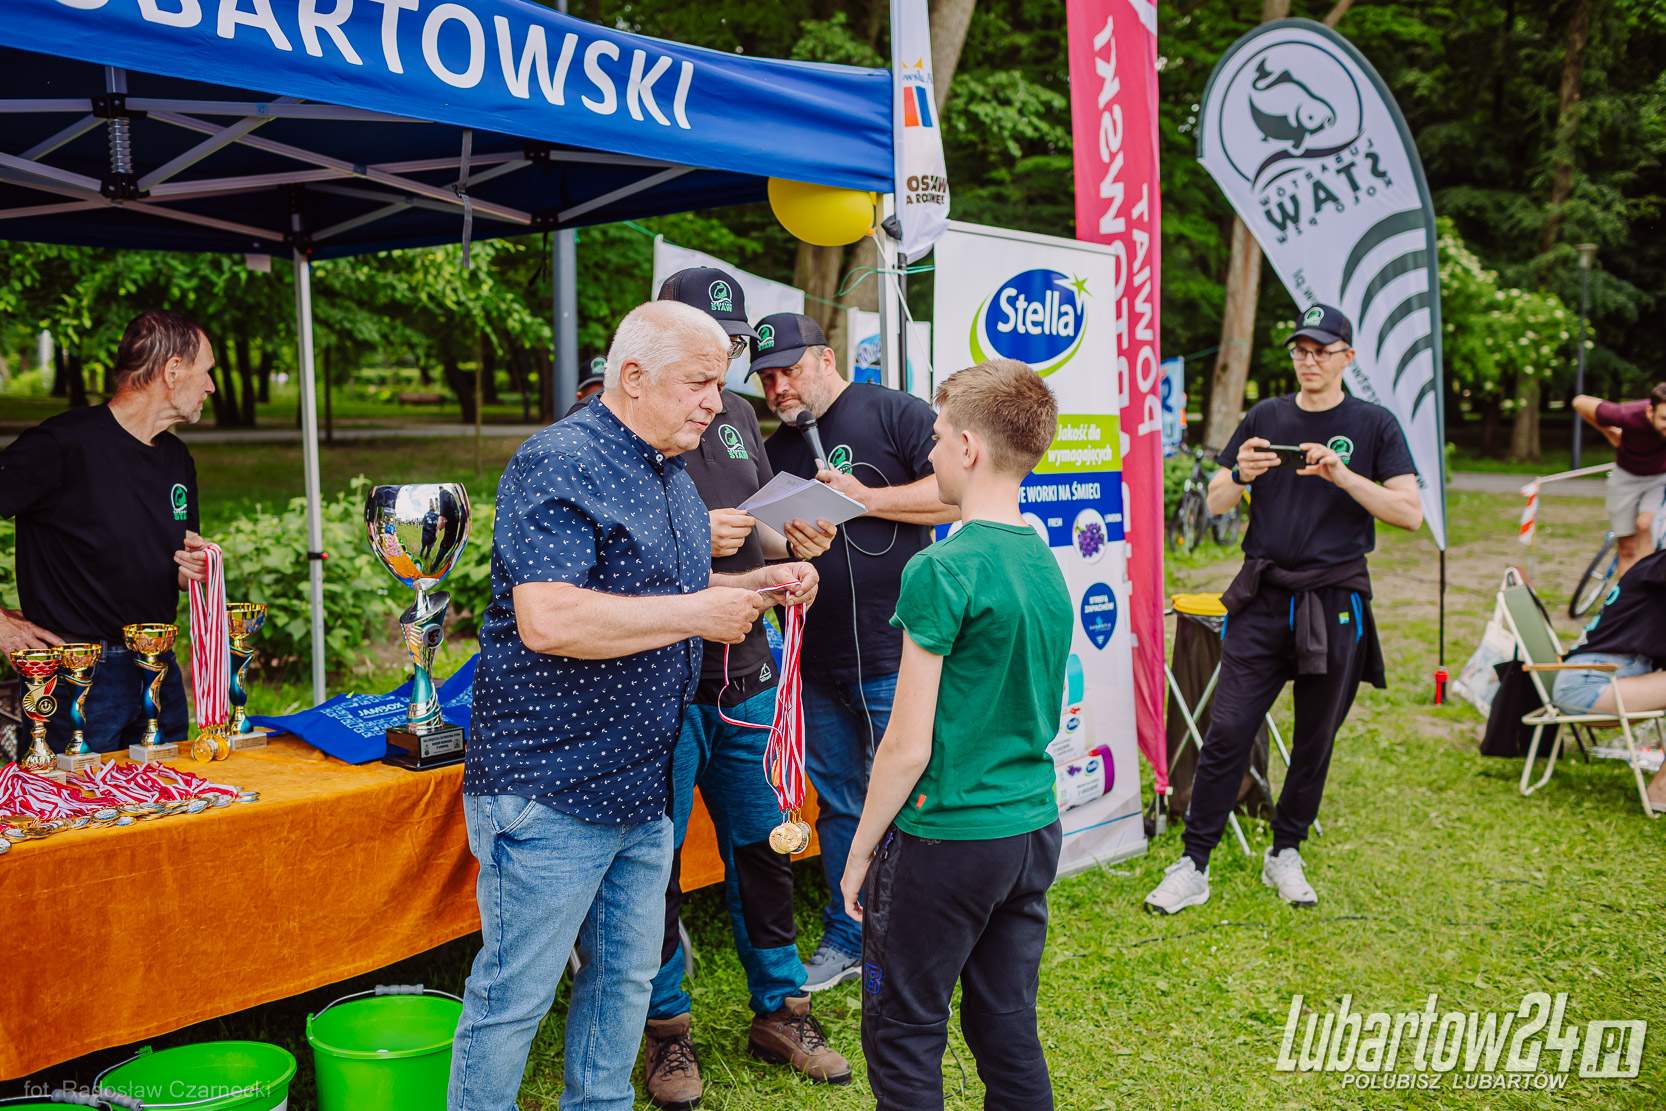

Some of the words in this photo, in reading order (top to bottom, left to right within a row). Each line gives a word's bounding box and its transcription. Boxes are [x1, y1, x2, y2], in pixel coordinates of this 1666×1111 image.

[997, 287, 1074, 337] Stella
[1056, 424, 1087, 441] Jakość
[1087, 424, 1101, 441] dla
[1047, 443, 1112, 467] wymagających
[1027, 485, 1057, 503] WORKI
[1058, 484, 1071, 501] NA
[1072, 481, 1100, 501] ŚMIECI
